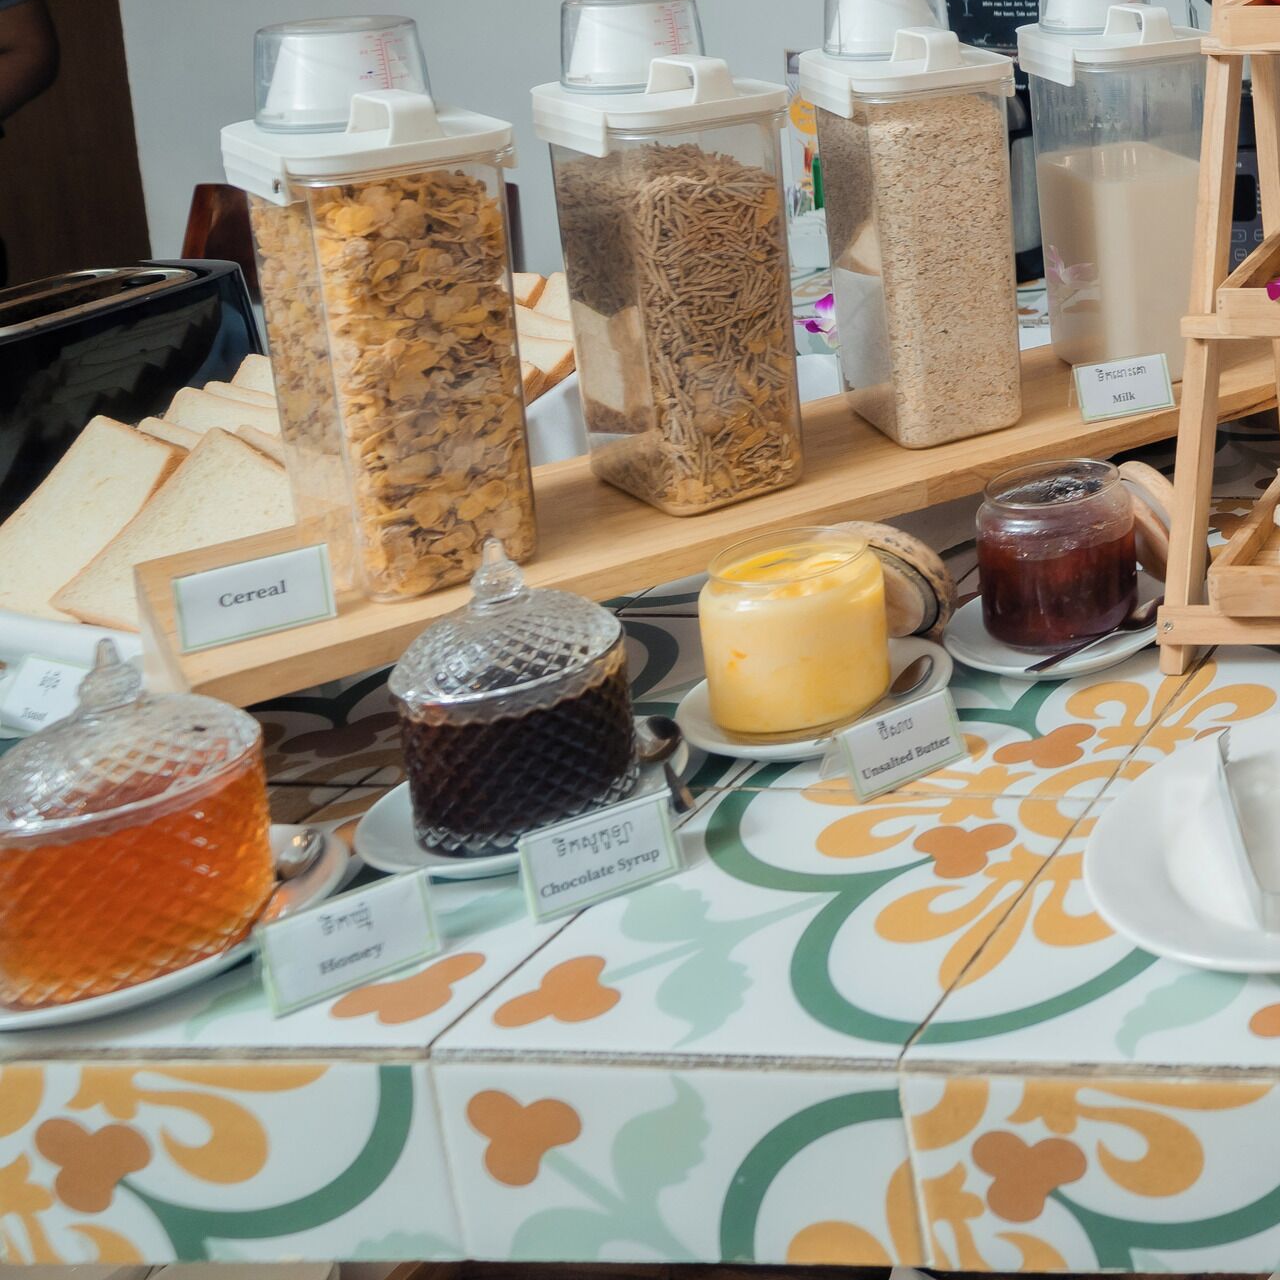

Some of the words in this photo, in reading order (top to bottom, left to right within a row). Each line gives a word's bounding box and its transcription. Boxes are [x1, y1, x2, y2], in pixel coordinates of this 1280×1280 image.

[1112, 391, 1136, 404] Milk
[217, 579, 288, 608] Cereal
[861, 749, 914, 780] Unsalted
[914, 735, 951, 758] Butter
[540, 865, 616, 899] Chocolate
[616, 848, 661, 872] Syrup
[317, 942, 384, 976] Honey
